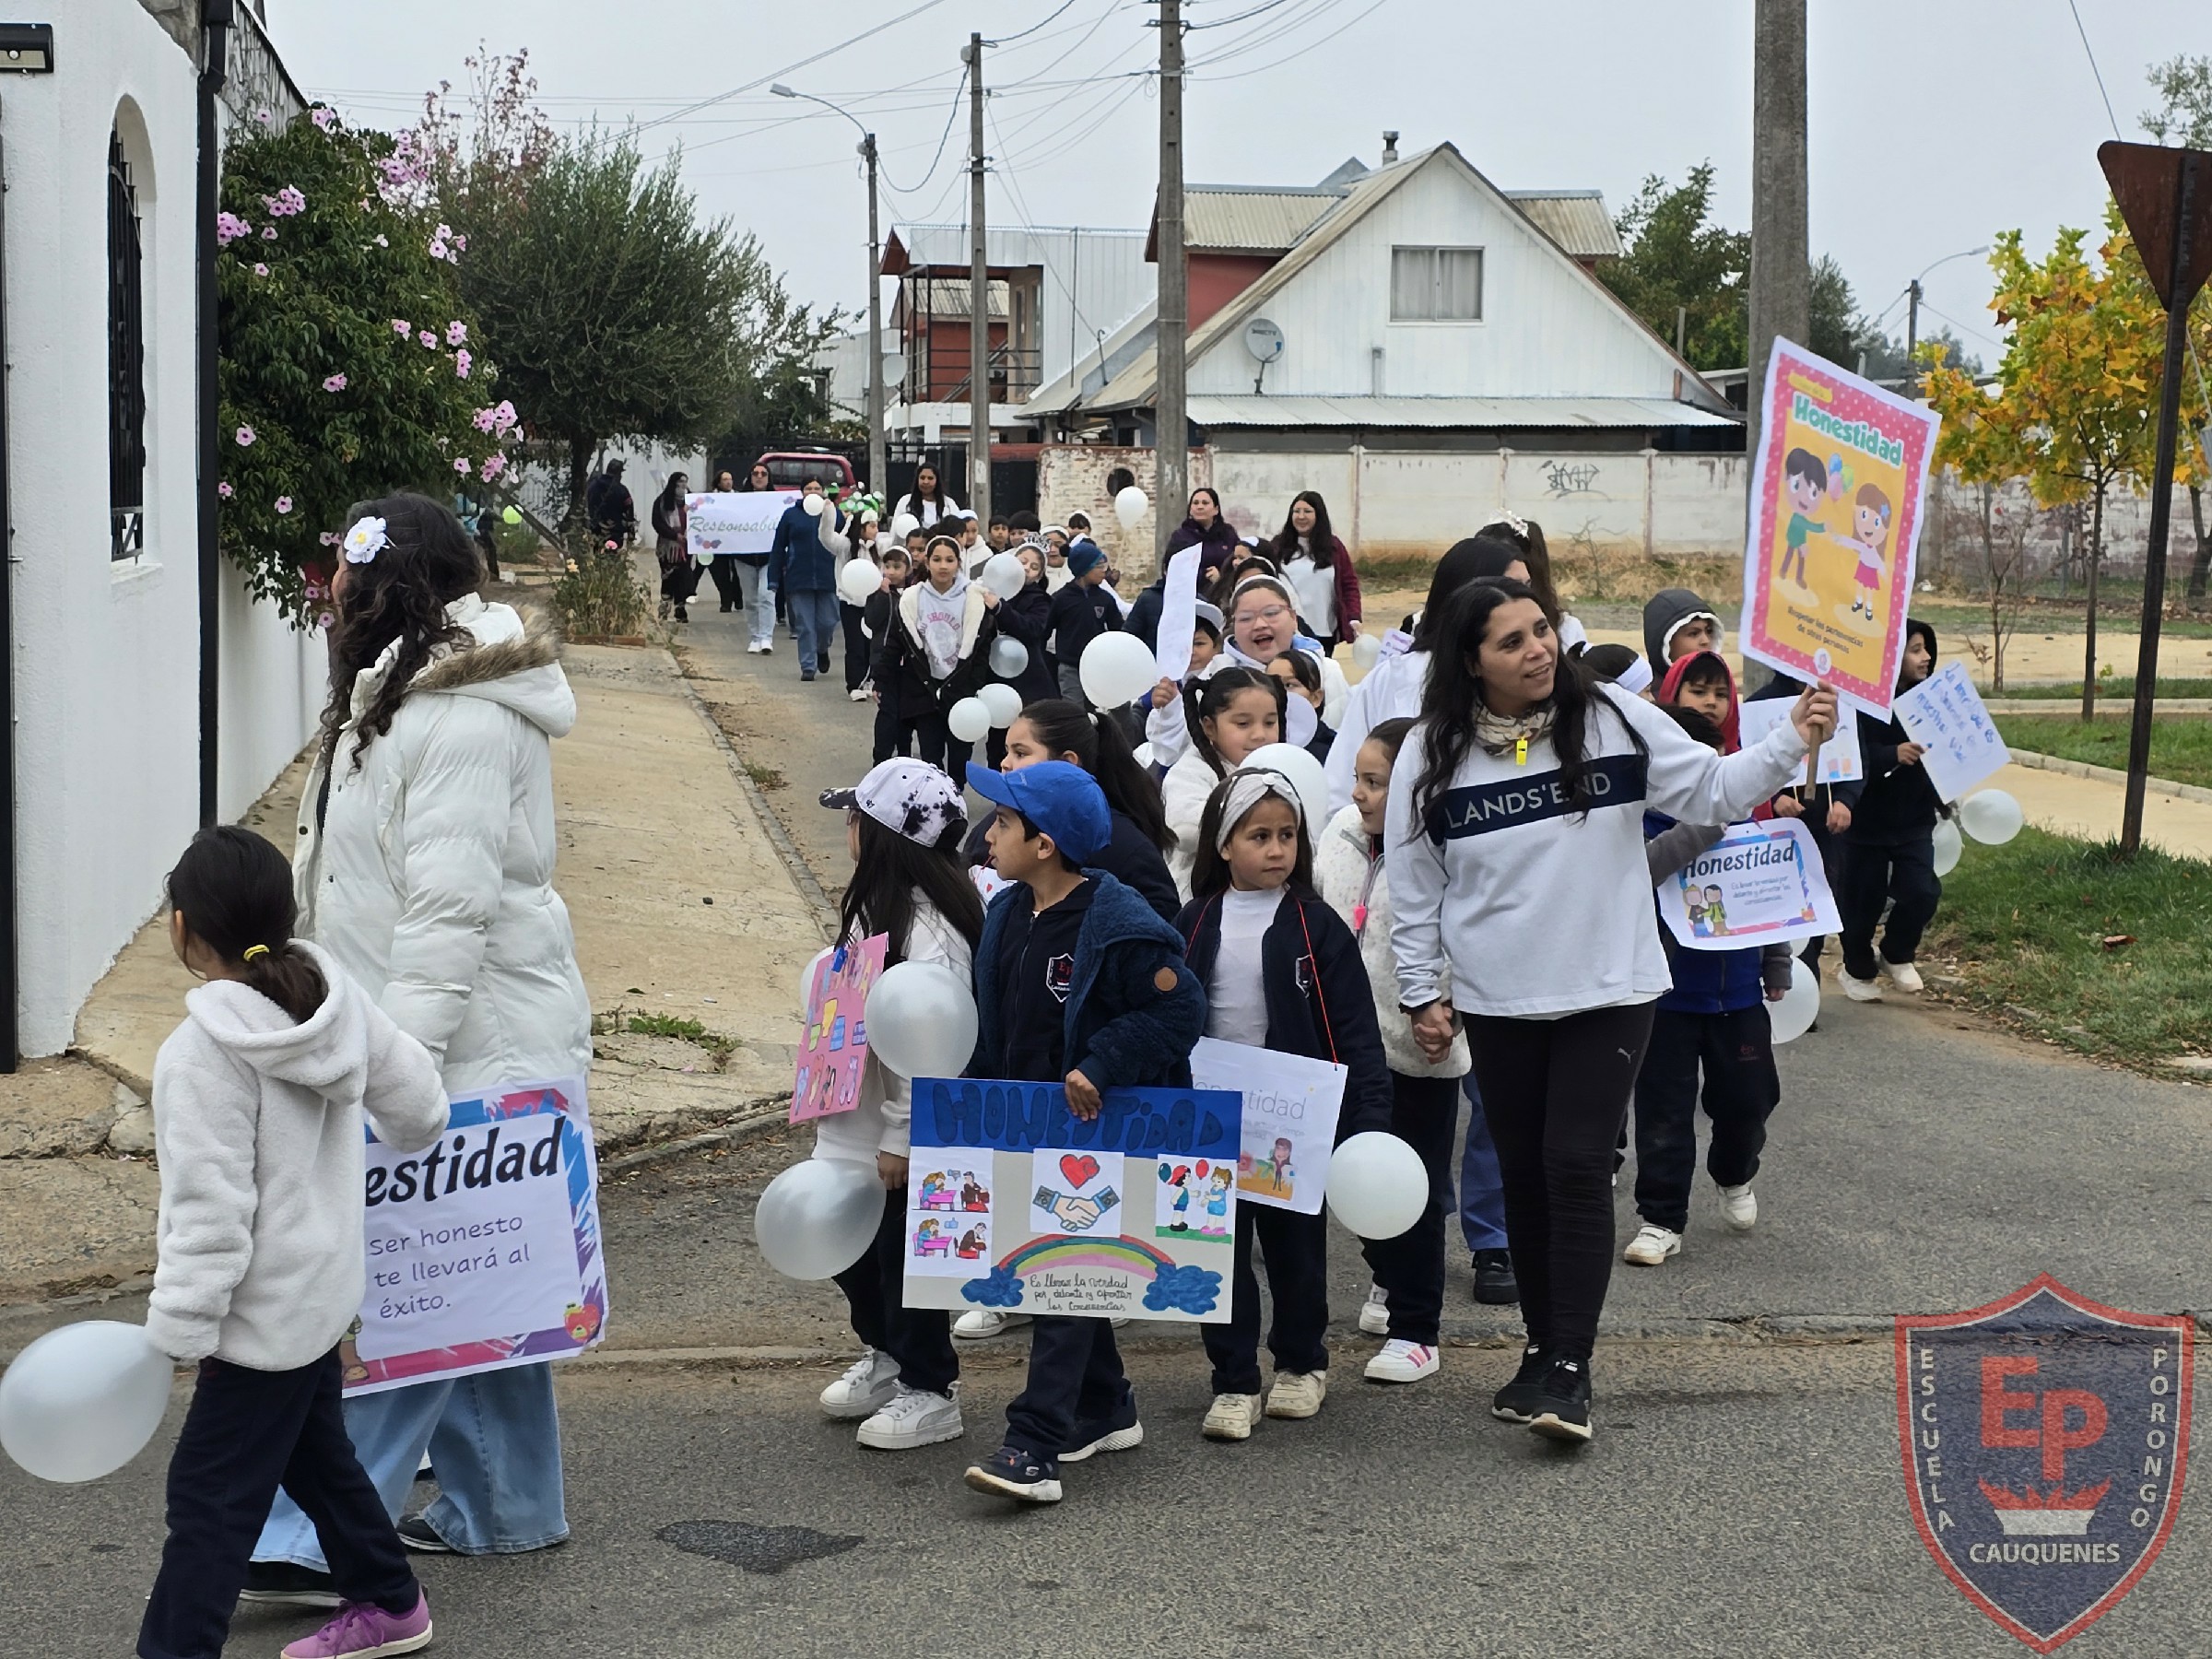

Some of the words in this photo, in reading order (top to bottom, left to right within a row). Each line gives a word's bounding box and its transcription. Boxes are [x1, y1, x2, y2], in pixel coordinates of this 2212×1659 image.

[1794, 394, 1903, 467] Honestidad
[688, 514, 780, 533] Responsabil
[1683, 839, 1794, 879] Honestidad
[365, 1116, 567, 1207] estidad
[369, 1235, 411, 1256] Ser
[420, 1216, 524, 1247] honesto
[374, 1268, 401, 1288] te
[411, 1250, 499, 1282] llevará
[508, 1243, 530, 1264] al
[1074, 1272, 1087, 1288] la
[379, 1292, 452, 1319] éxito.
